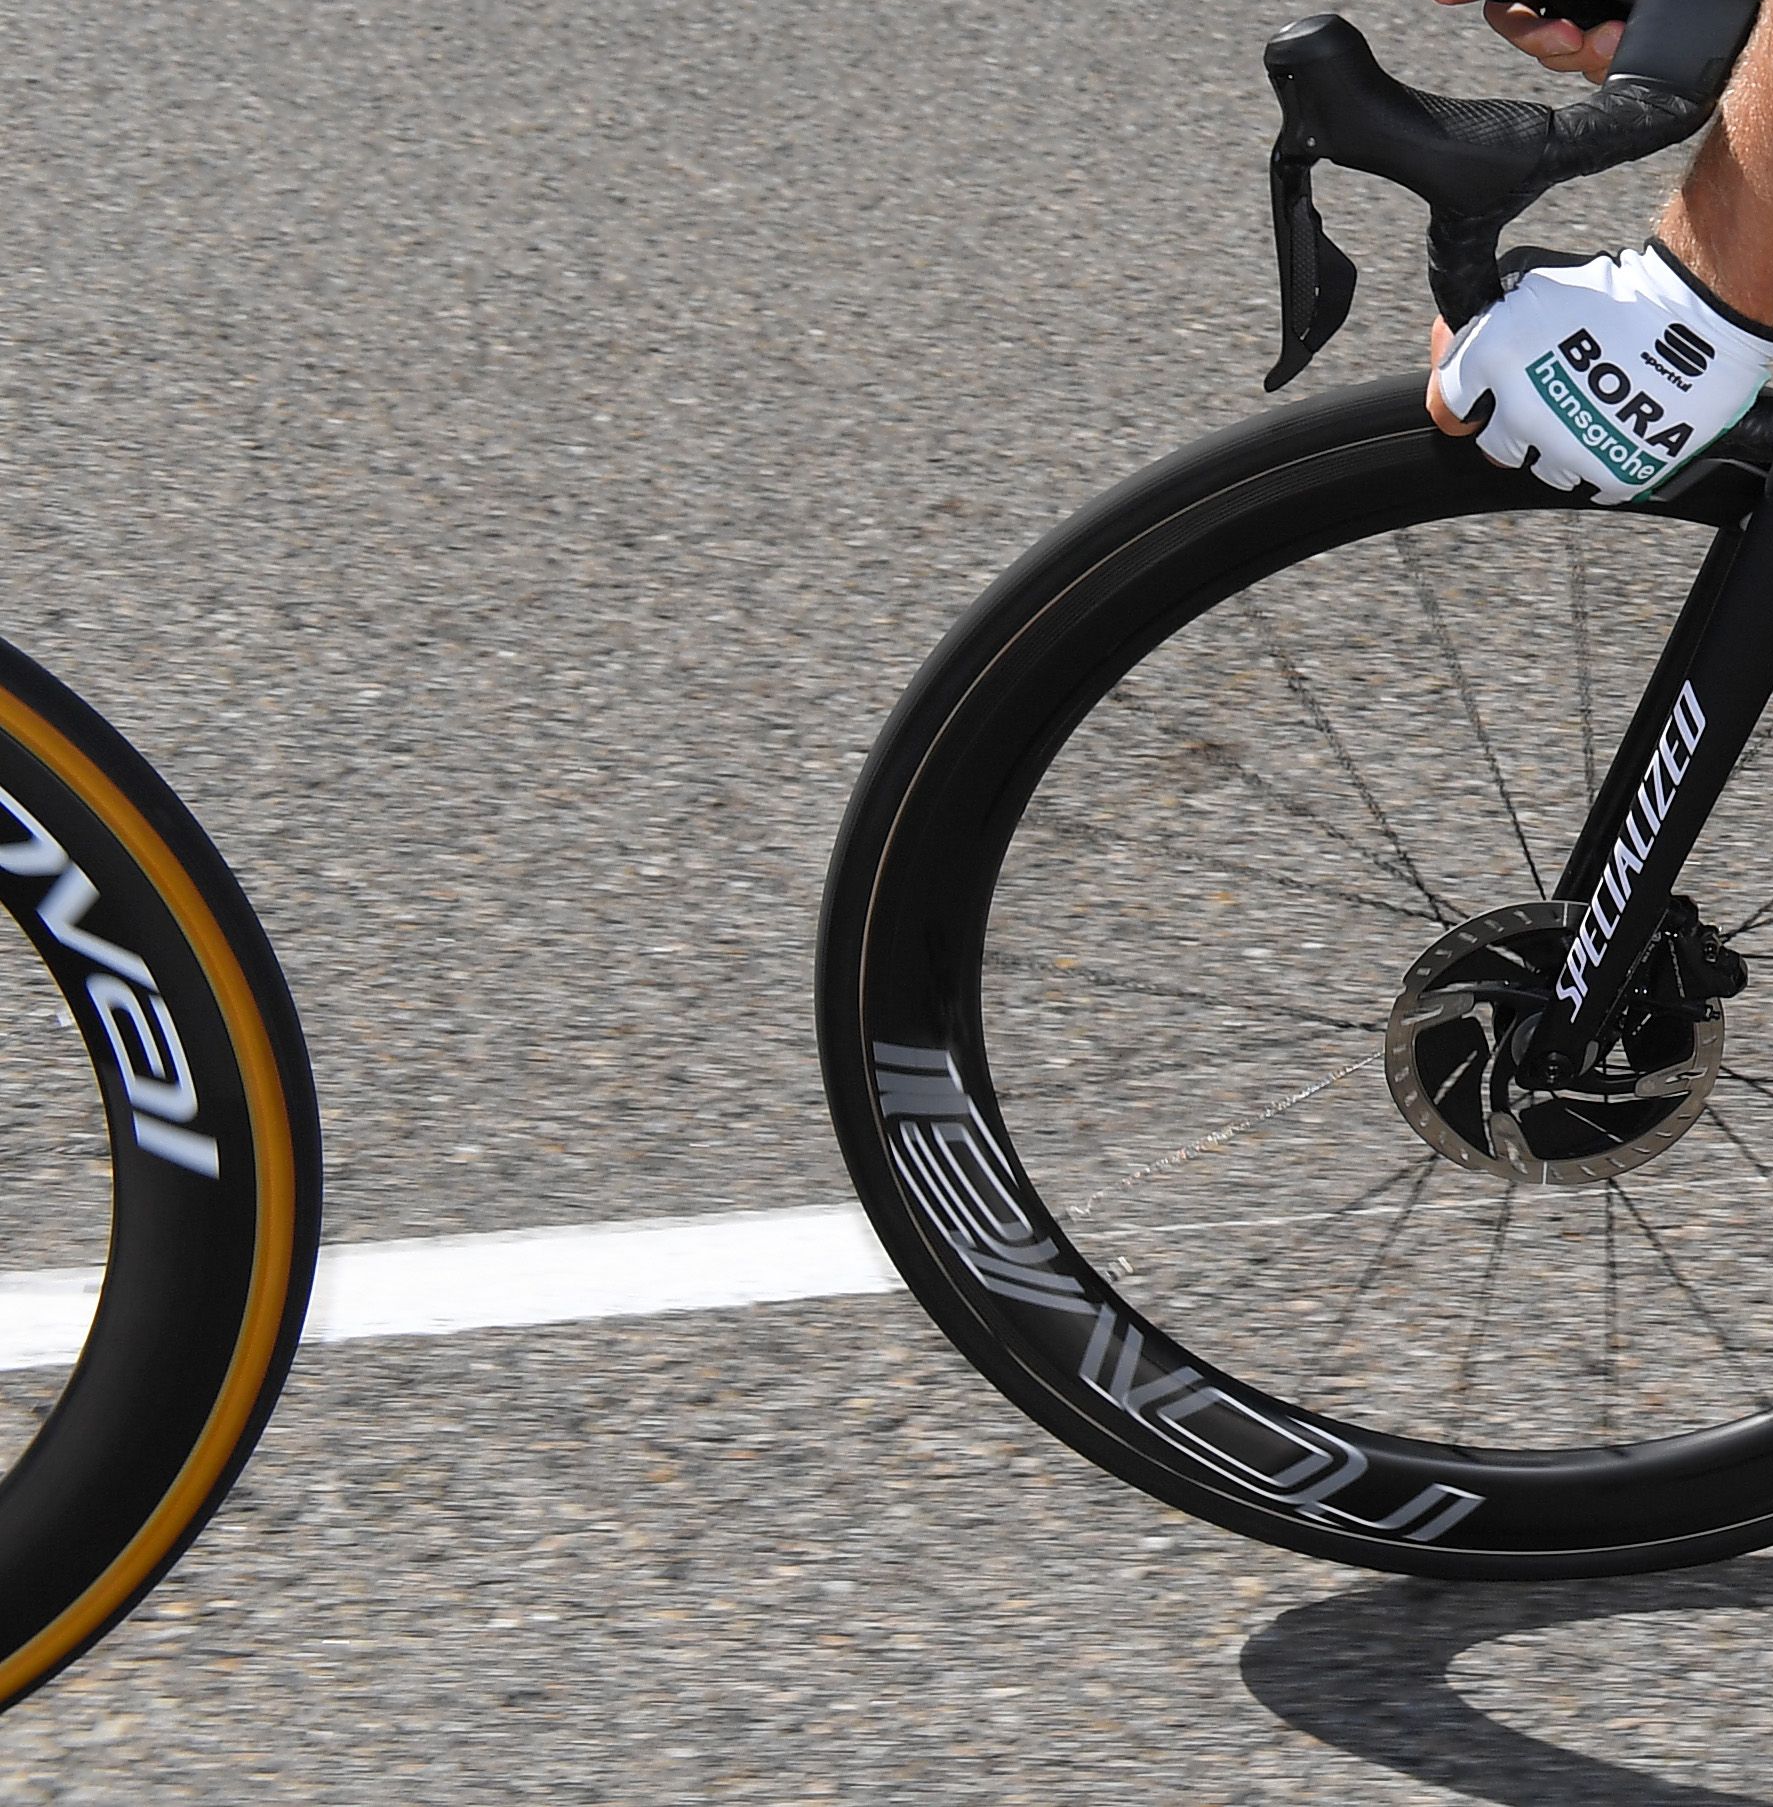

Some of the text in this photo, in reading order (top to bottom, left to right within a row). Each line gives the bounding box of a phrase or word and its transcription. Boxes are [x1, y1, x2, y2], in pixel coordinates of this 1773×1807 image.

[1535, 359, 1653, 481] hansgrohe
[1556, 327, 1696, 459] BORA
[1640, 350, 1694, 393] sportful
[1555, 679, 1708, 1024] SPECIALIZED
